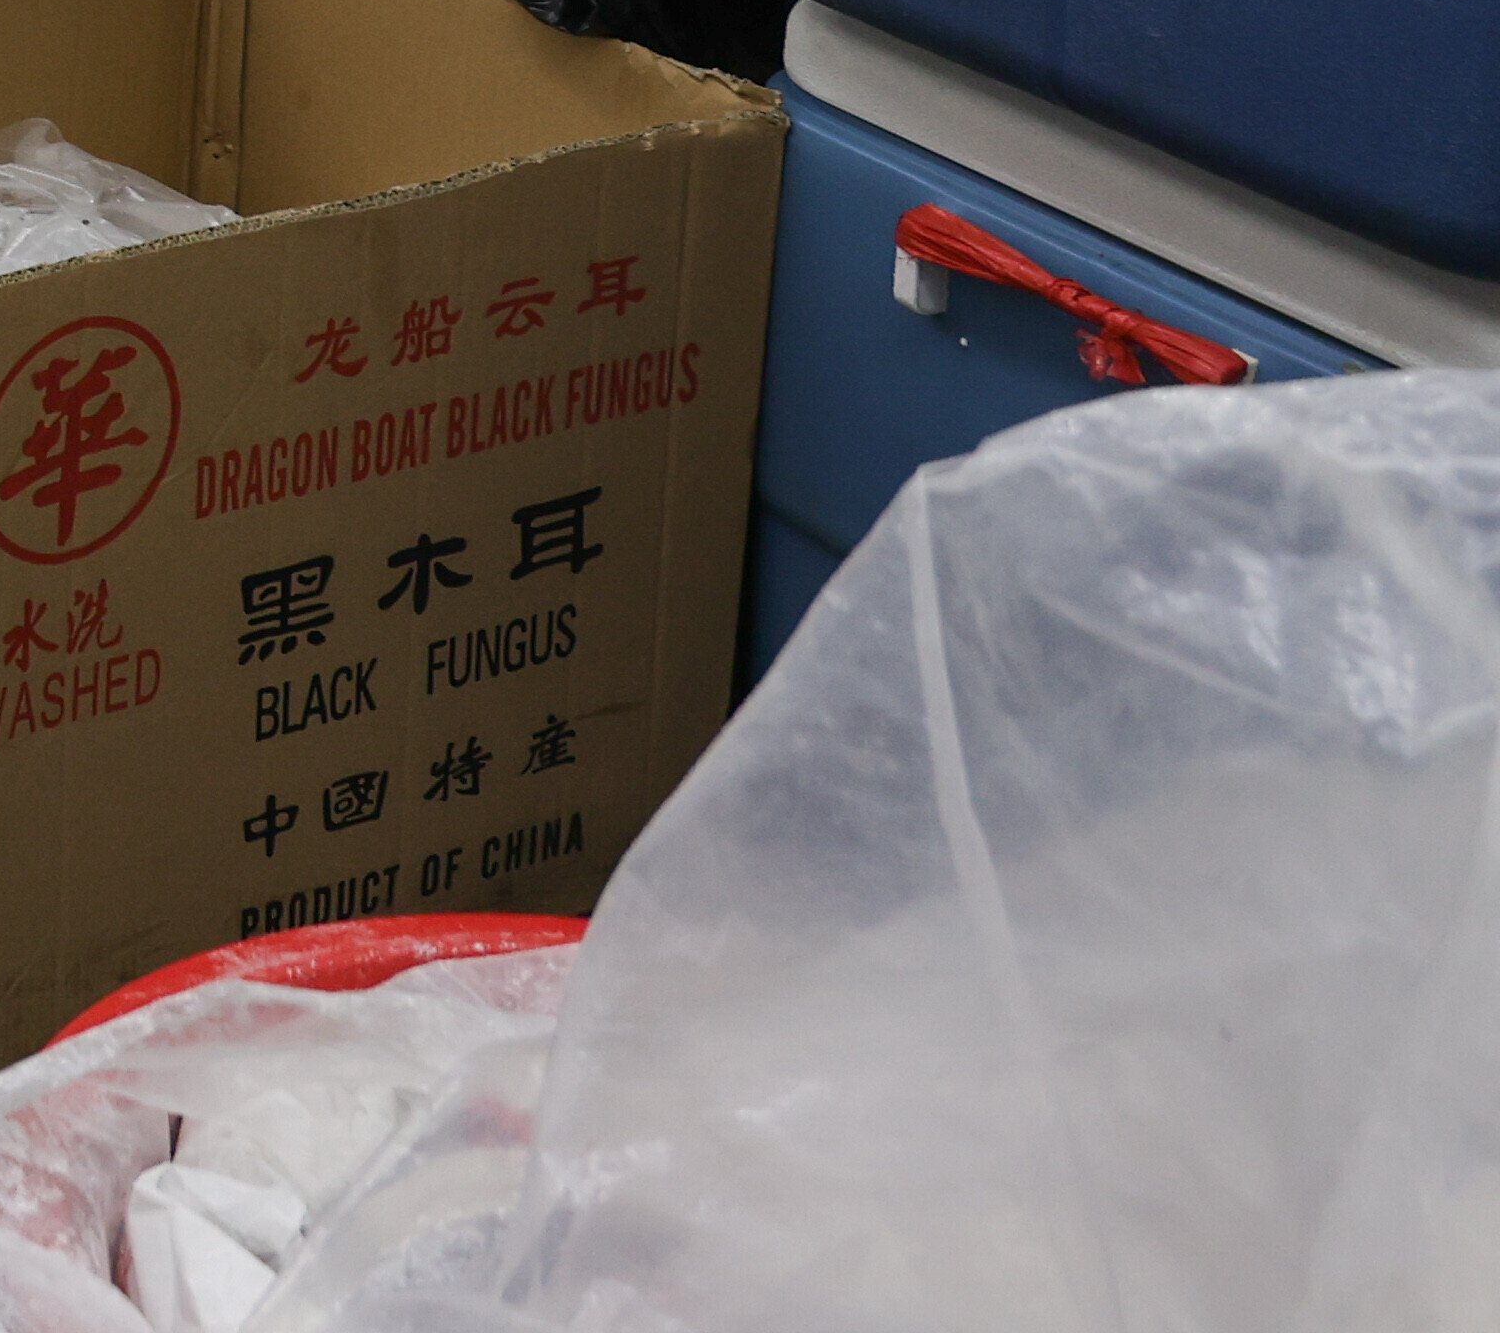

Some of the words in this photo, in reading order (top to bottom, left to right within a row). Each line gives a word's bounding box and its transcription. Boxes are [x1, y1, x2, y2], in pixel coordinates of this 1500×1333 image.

[293, 255, 647, 384] 龙船云耳
[195, 425, 339, 520] DRAGON
[351, 401, 438, 483] BOAT
[446, 374, 556, 460] BLACK
[565, 342, 700, 430] FUNGUS
[2, 578, 125, 673] 水洗
[238, 486, 603, 665] 黑木耳
[255, 657, 378, 742] BLACK
[426, 603, 577, 695] FUNGUS
[241, 863, 400, 939] PRODUCT
[420, 847, 463, 897] OF
[481, 811, 584, 880] CHINA
